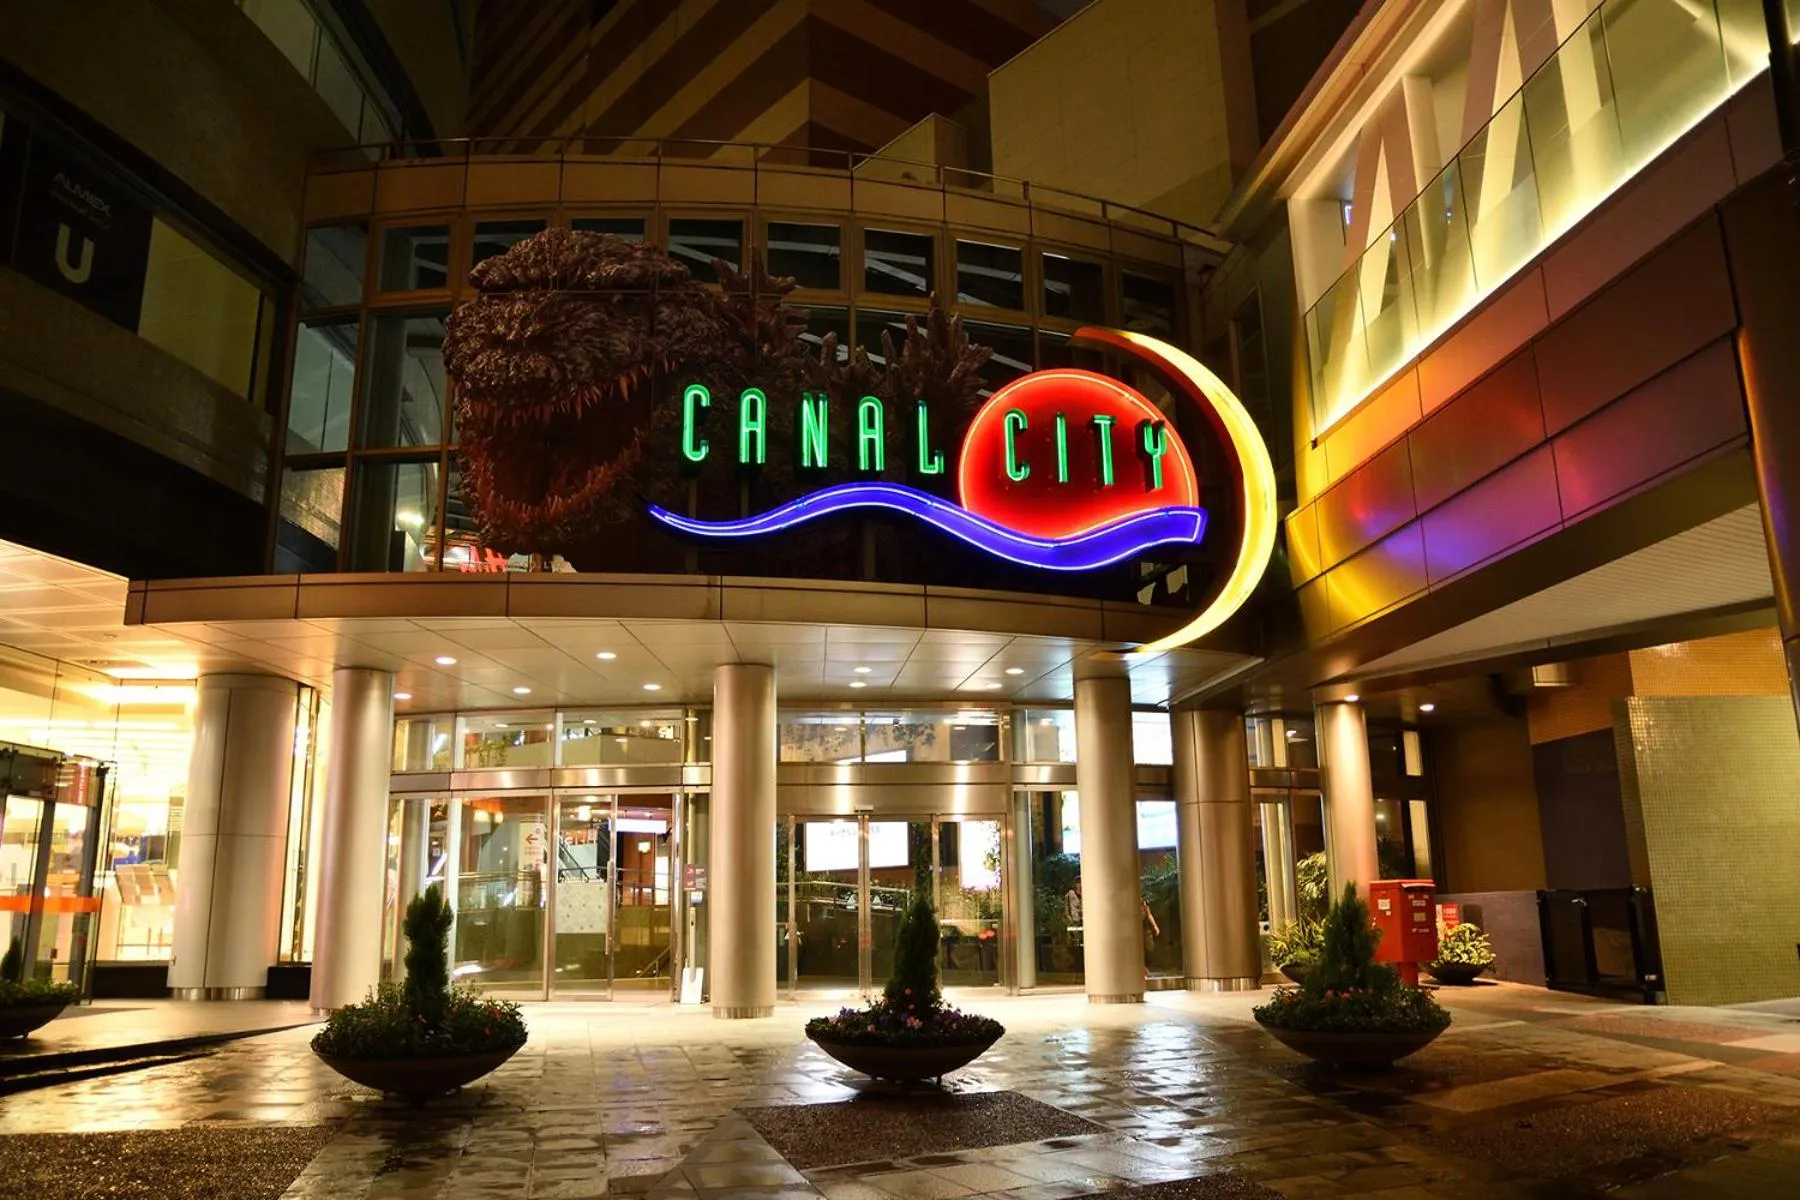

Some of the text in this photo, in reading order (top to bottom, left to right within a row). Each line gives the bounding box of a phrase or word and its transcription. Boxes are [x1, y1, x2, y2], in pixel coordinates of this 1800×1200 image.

[56, 223, 95, 283] U
[682, 384, 1167, 490] CANAL CITY
